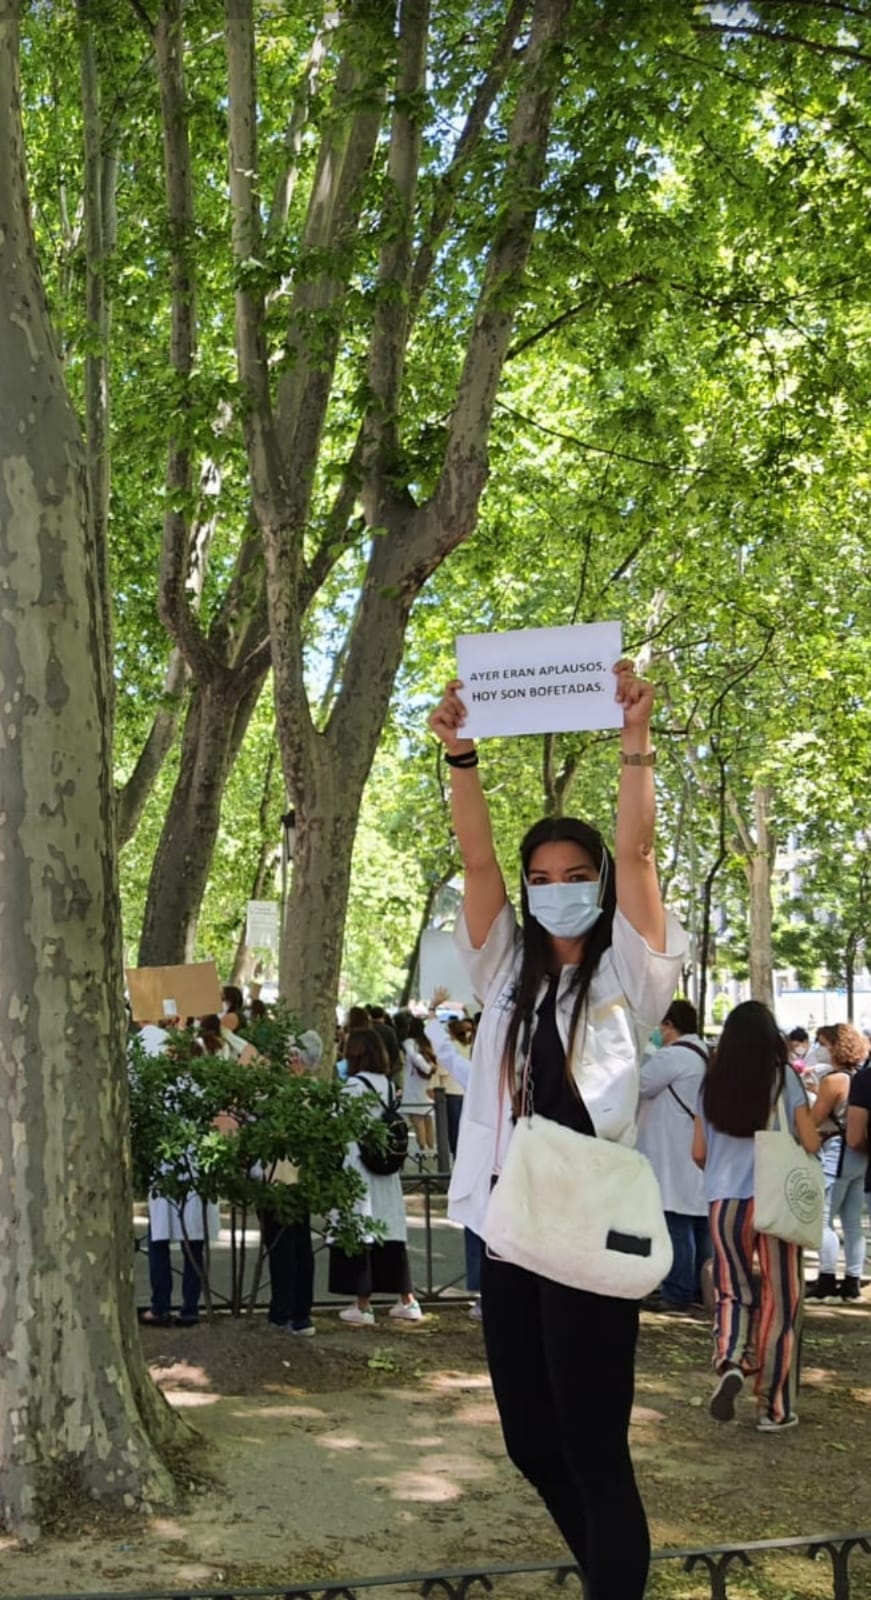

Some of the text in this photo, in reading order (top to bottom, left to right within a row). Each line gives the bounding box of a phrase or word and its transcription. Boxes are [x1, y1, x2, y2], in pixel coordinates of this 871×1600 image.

[470, 661, 607, 681] AYER ERAN APLAUSOS,
[472, 682, 605, 702] HOY SON BOFETADAS.
